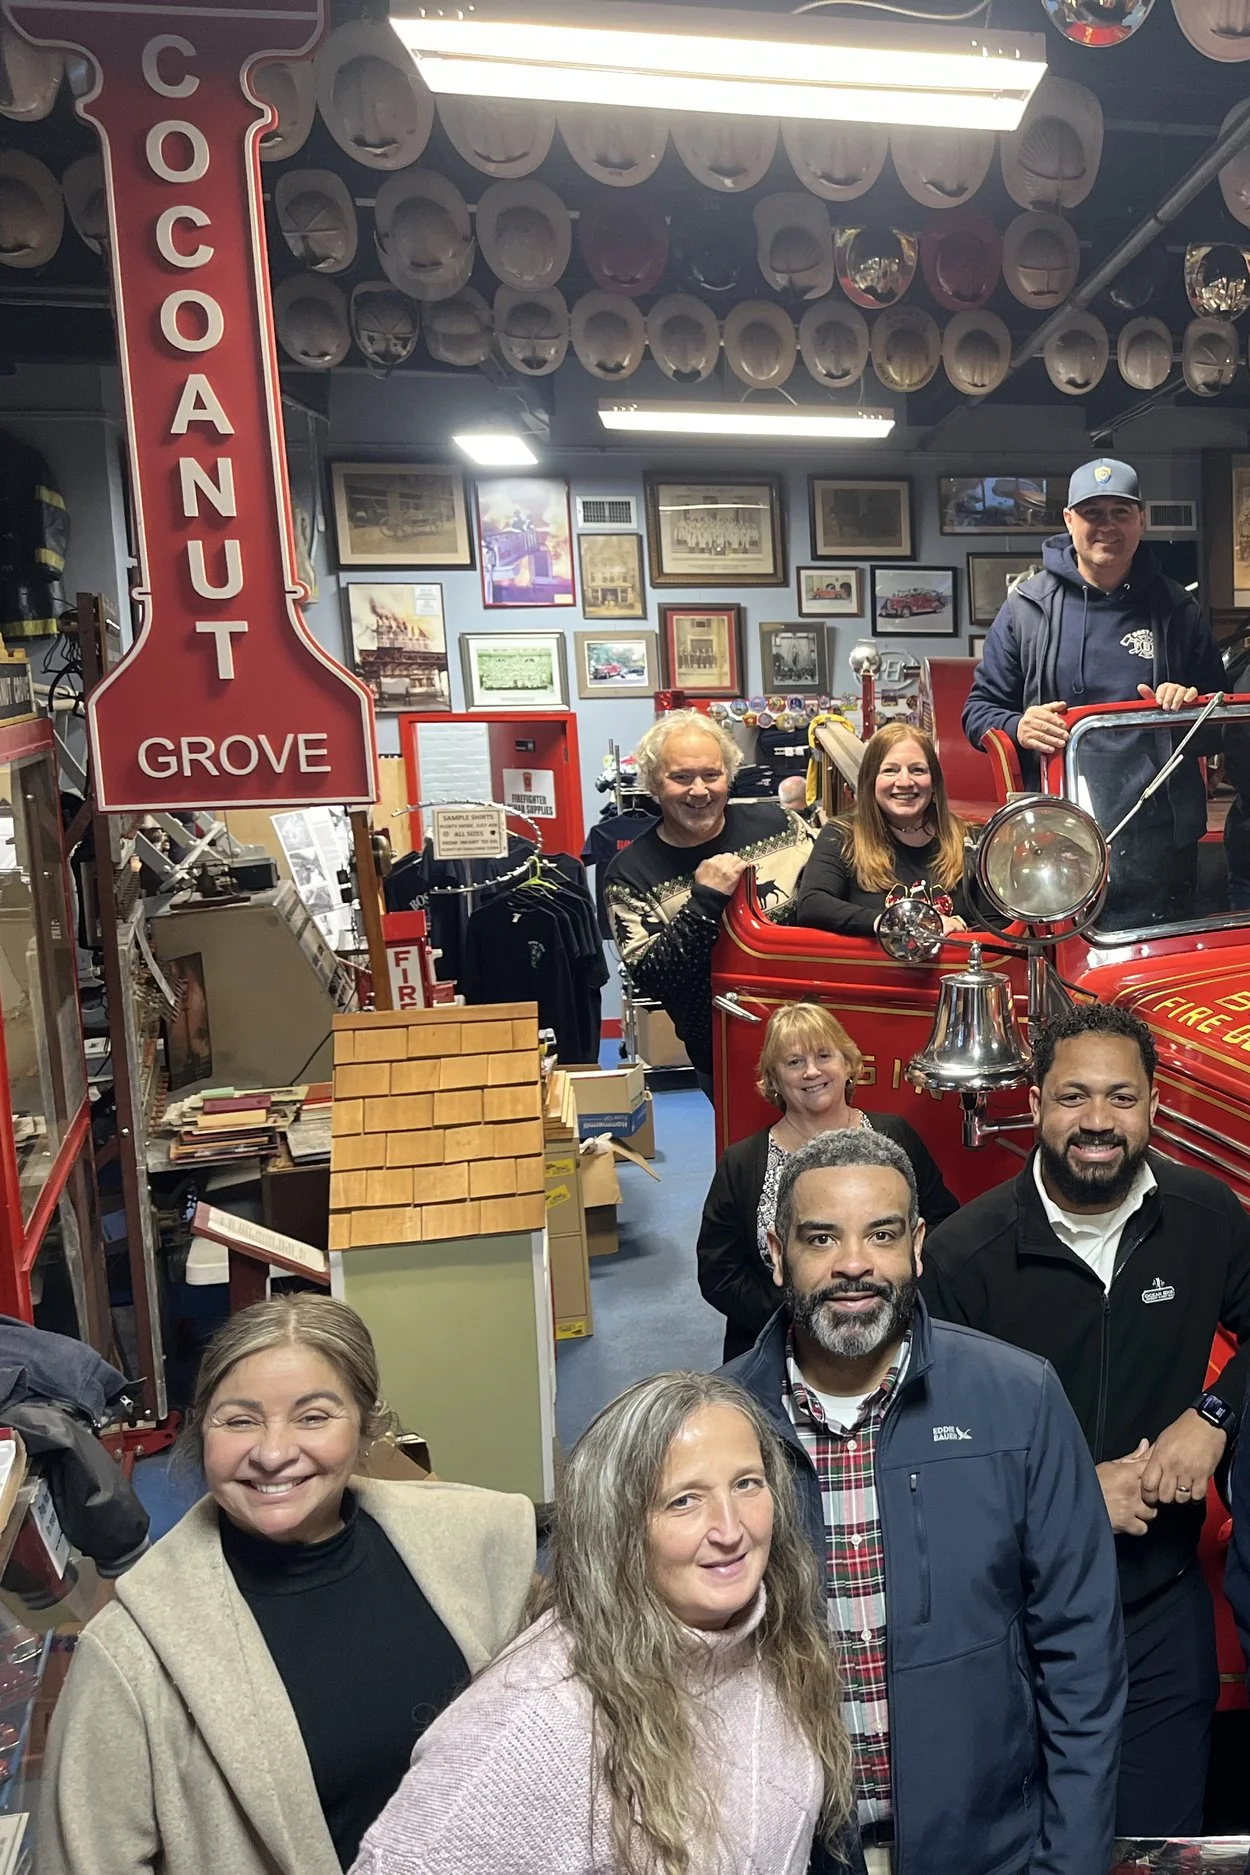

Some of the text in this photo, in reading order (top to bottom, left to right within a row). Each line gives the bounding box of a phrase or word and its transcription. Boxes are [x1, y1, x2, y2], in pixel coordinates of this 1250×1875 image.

[141, 34, 248, 680] COCOANUT
[138, 733, 331, 778] GROVE
[511, 793, 547, 805] FIREFIGHTER
[526, 804, 554, 815] SUPPLIES
[442, 813, 494, 822] SAMPLE SHIRTS
[1151, 996, 1233, 1034] FIRE
[932, 1425, 955, 1435] EDDIE
[933, 1432, 958, 1442] BAUER
